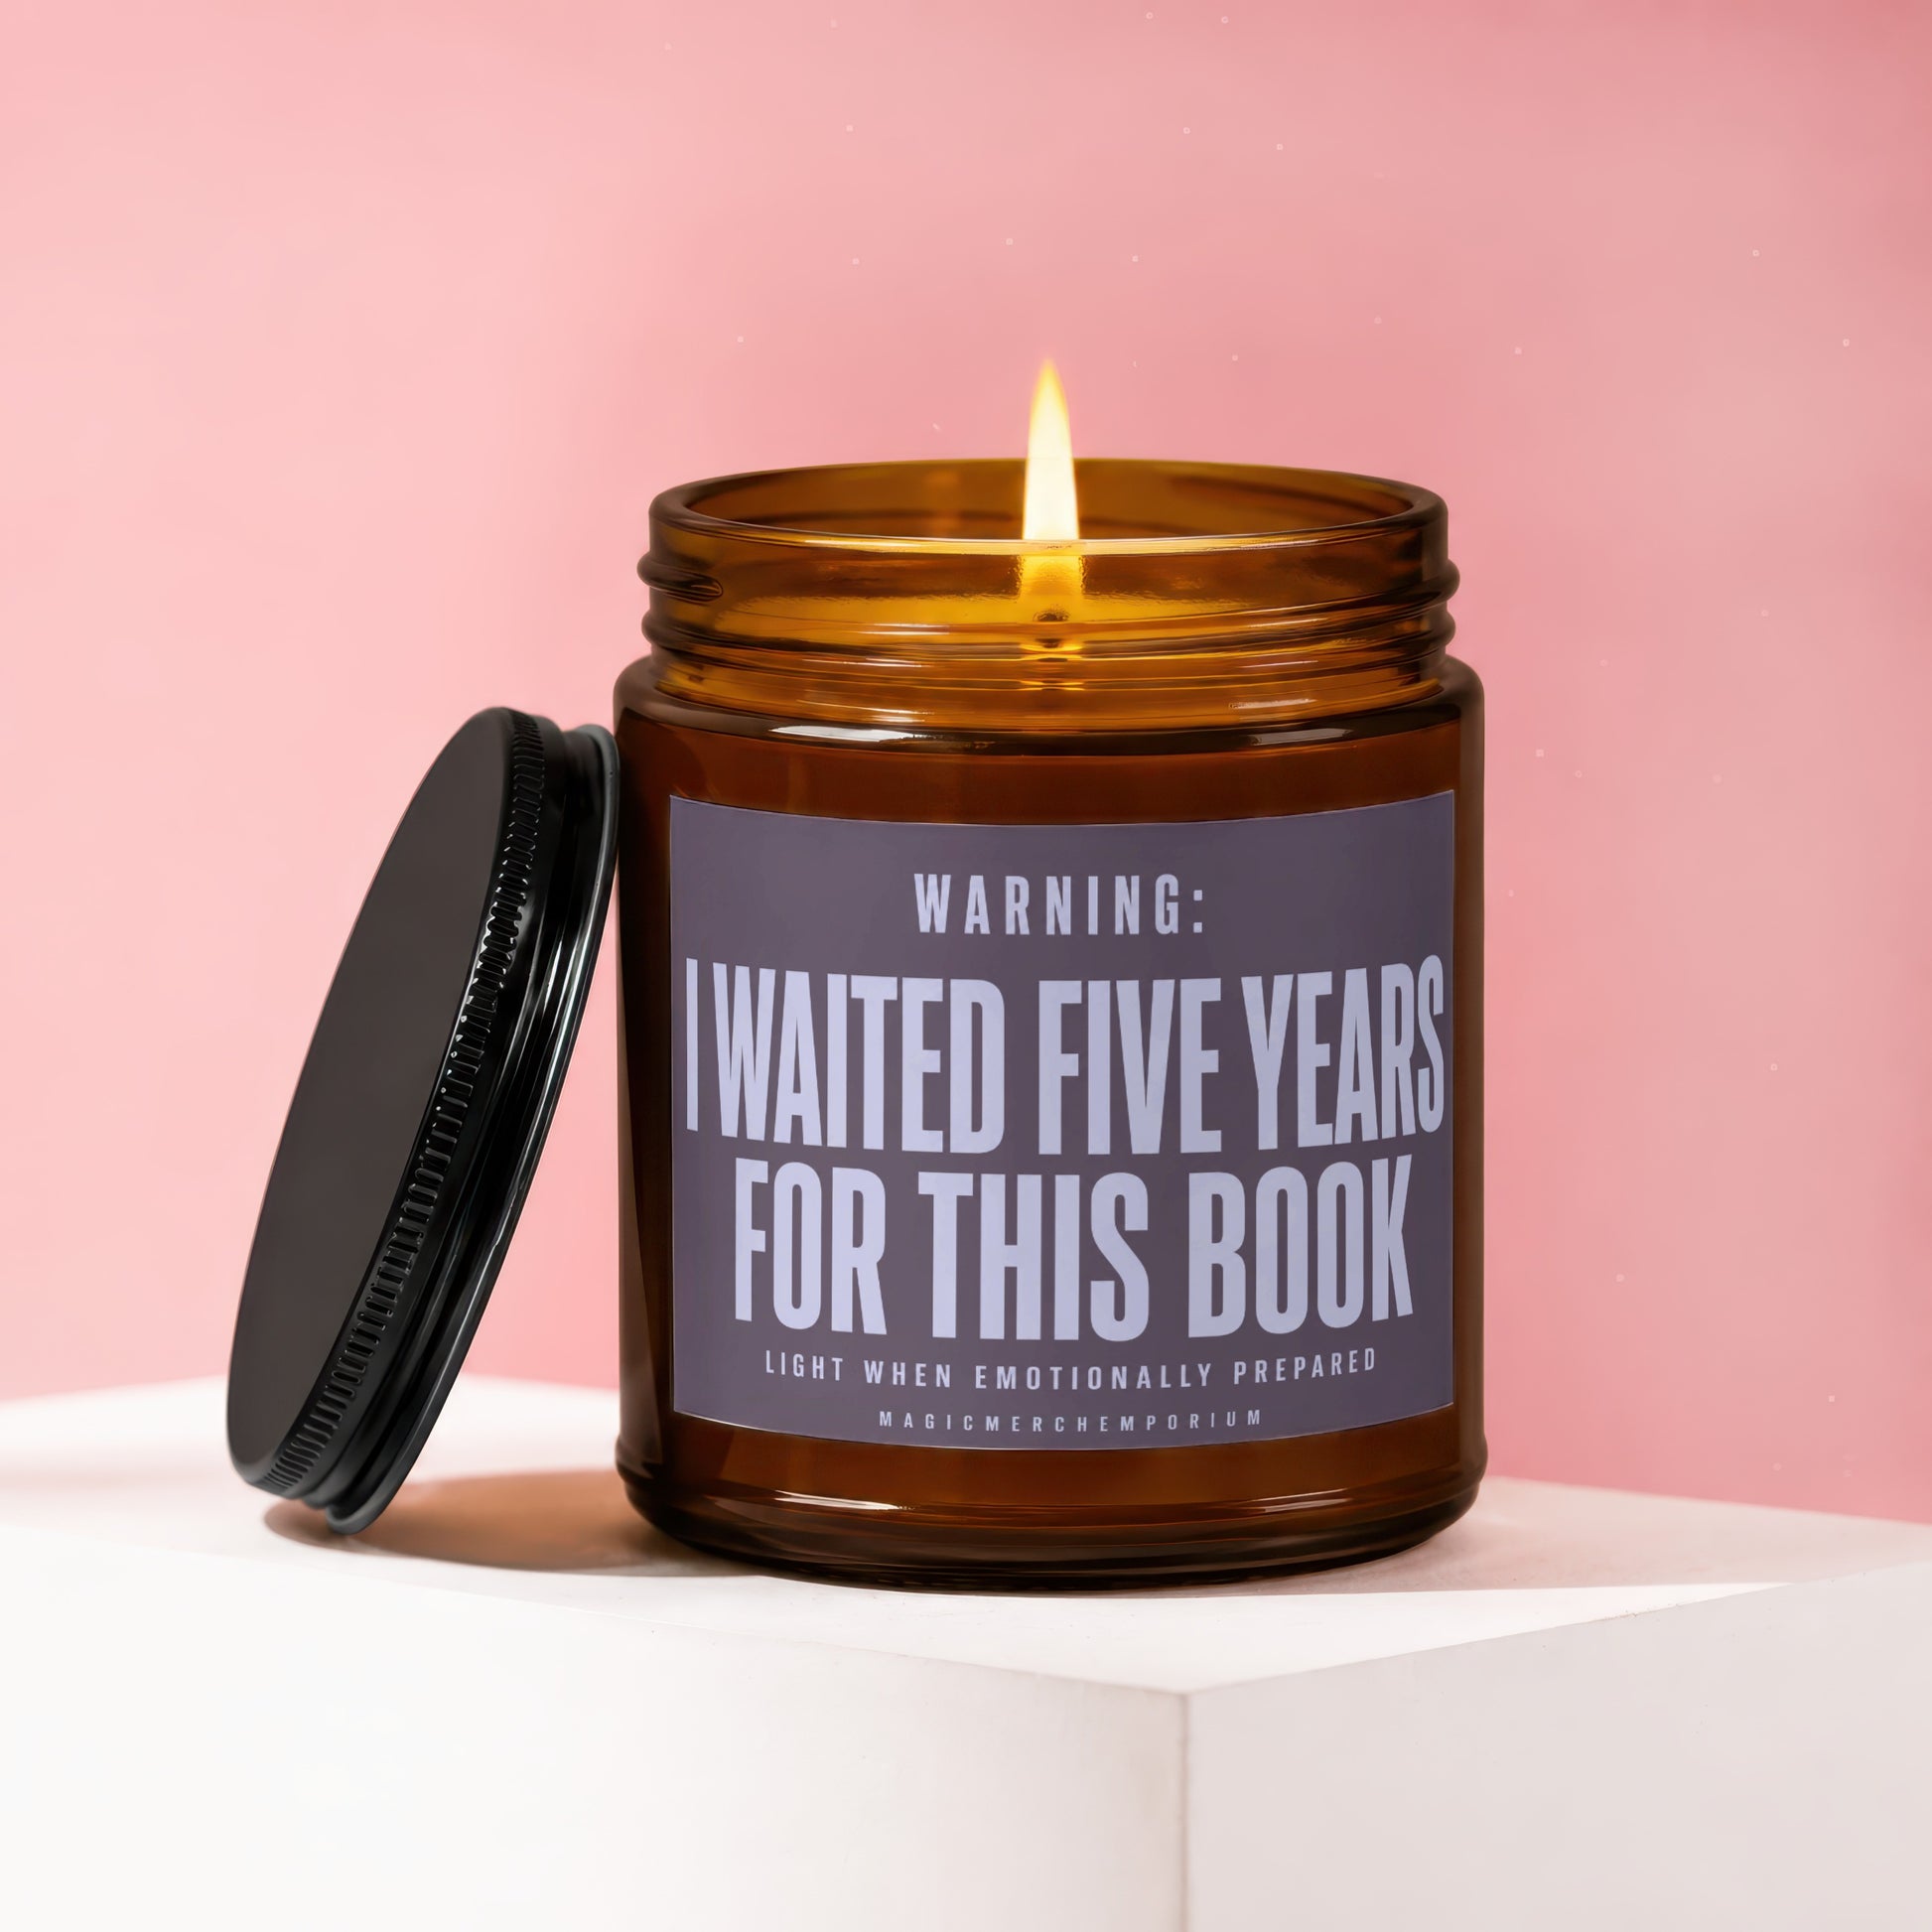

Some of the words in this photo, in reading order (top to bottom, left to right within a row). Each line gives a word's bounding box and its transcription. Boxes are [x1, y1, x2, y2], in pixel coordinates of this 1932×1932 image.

[913, 873, 1203, 935] WARNING:
[685, 957, 699, 1132] I
[712, 961, 1006, 1155] WAITED
[1038, 977, 1222, 1156] FIVE
[1240, 954, 1446, 1151] YEARS
[735, 1157, 888, 1335] FOR
[917, 1171, 1150, 1342] THIS
[1187, 1154, 1414, 1338] BOOK
[765, 1349, 844, 1382] LIGHT
[863, 1359, 951, 1388] WHEN
[975, 1363, 1211, 1391] EMOTIONALLY
[1233, 1347, 1375, 1385] PREPARED
[879, 1409, 1261, 1433] MAGICMERCHEMPORIUM
